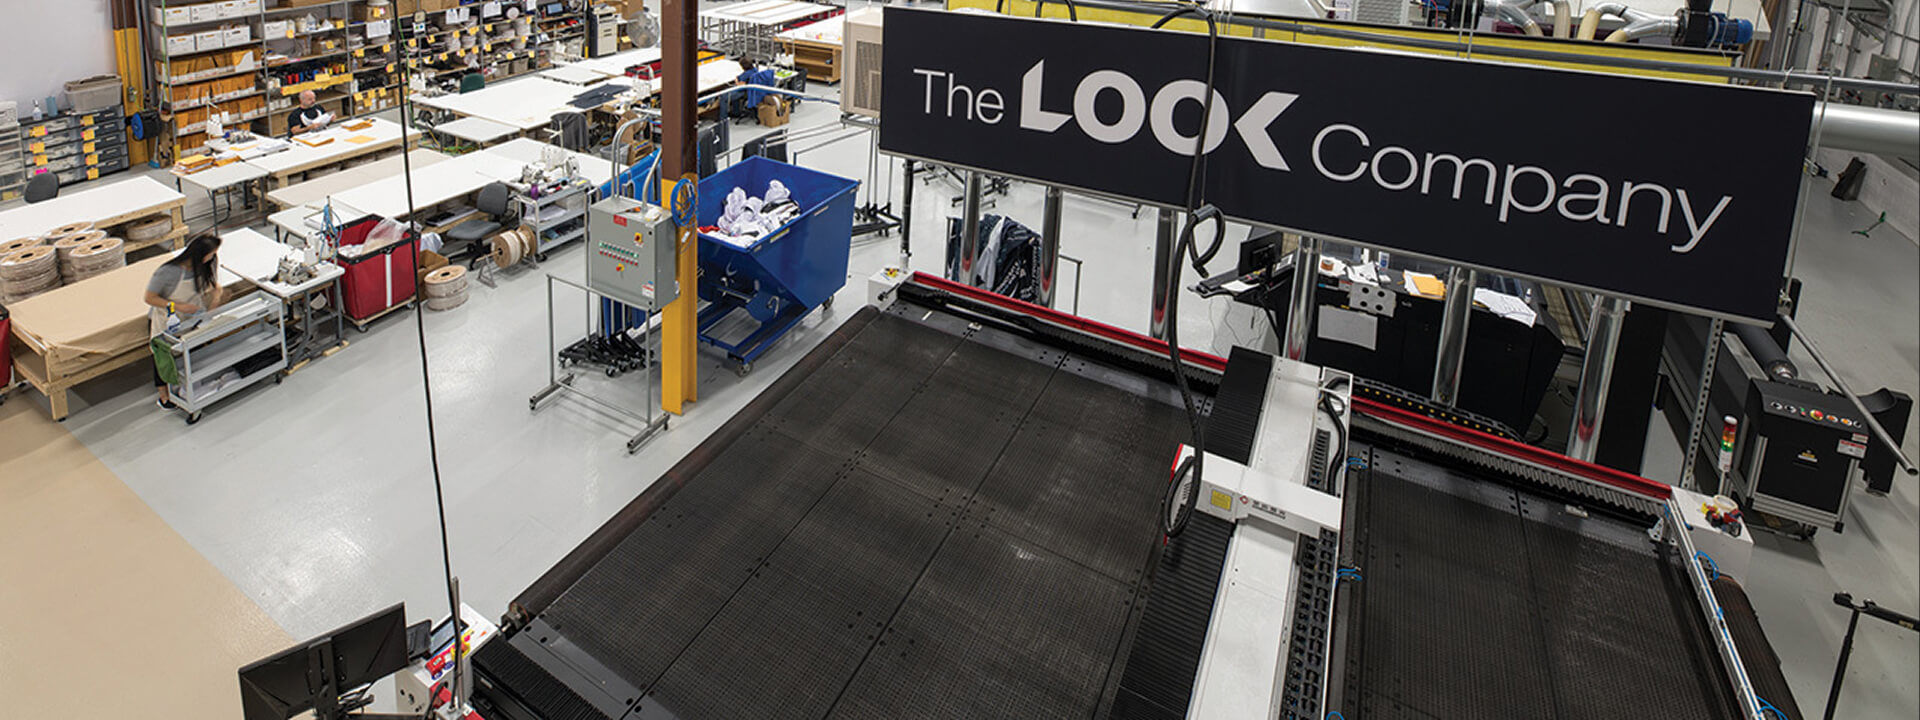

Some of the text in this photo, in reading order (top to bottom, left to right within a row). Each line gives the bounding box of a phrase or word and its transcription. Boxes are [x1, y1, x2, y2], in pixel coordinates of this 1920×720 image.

[912, 59, 1733, 254] The LOOK Company
